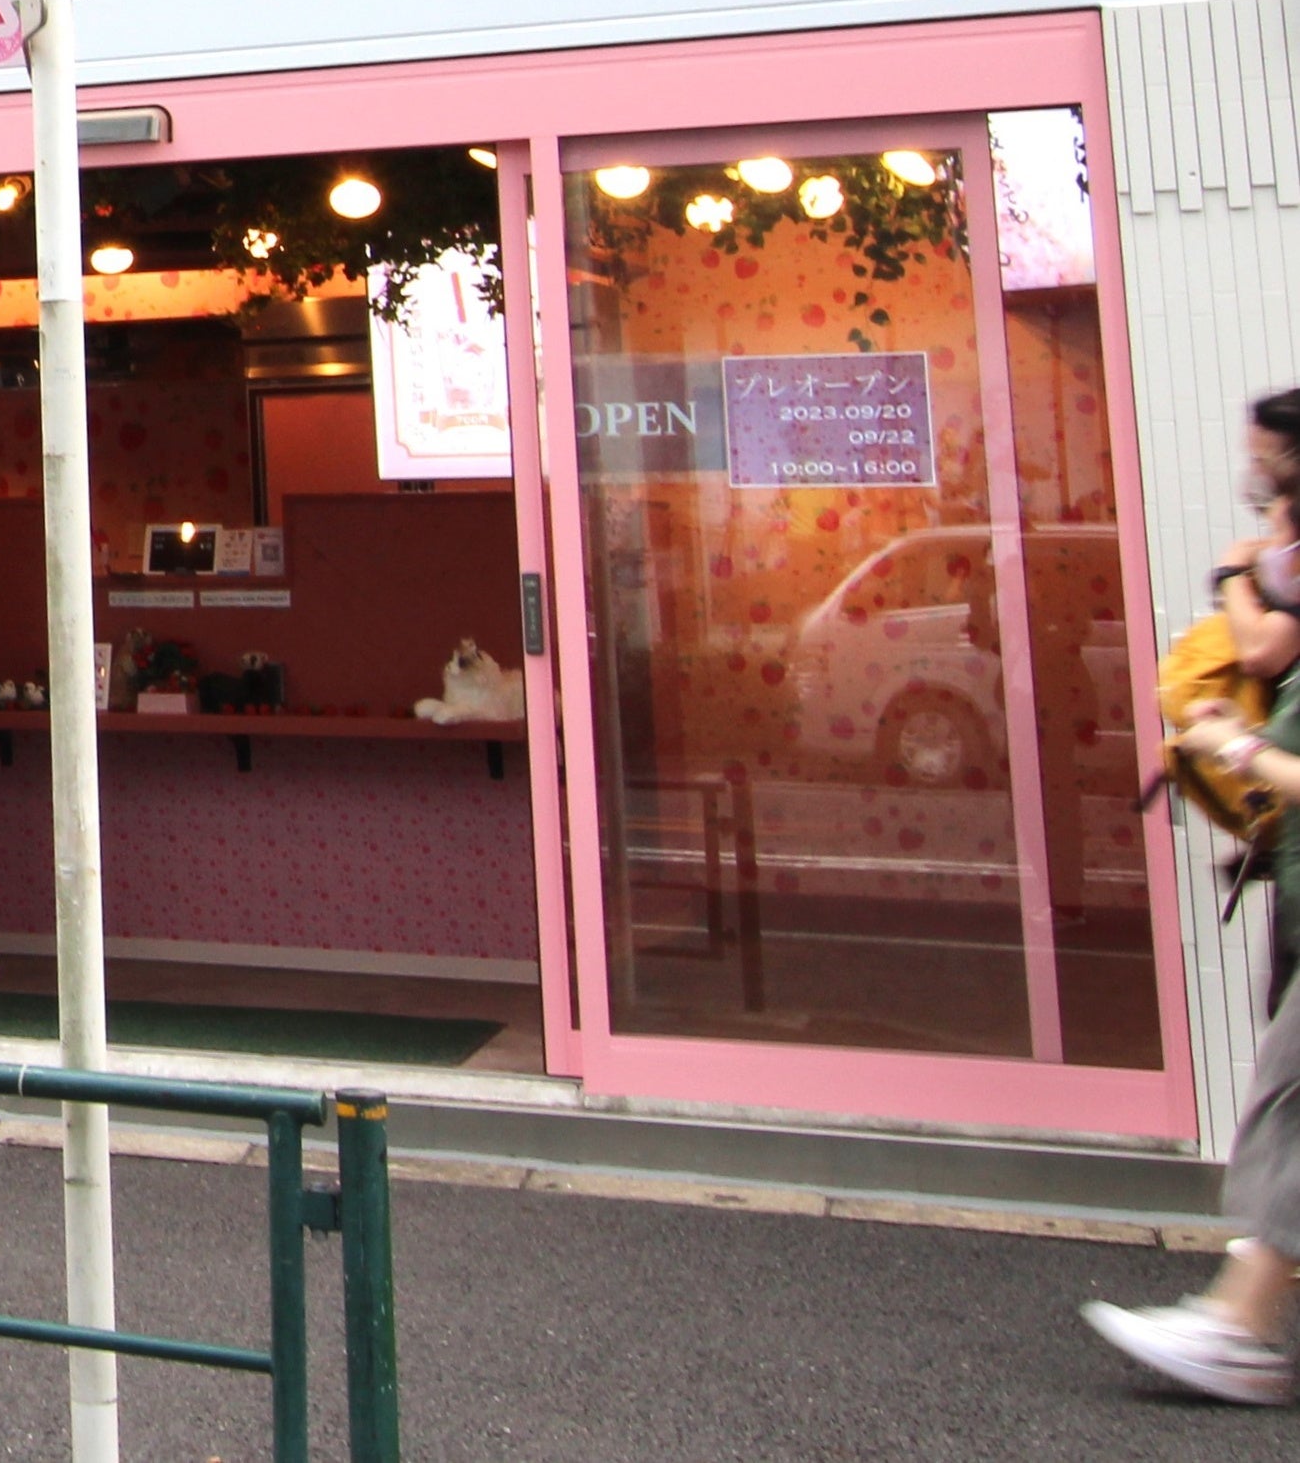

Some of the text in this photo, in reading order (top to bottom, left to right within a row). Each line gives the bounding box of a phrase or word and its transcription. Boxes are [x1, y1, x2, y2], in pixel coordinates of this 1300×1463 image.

[734, 369, 911, 399] プレオープン
[574, 399, 698, 437] OPEN
[779, 403, 913, 422] 2023.09/20
[848, 429, 916, 446] 09/22
